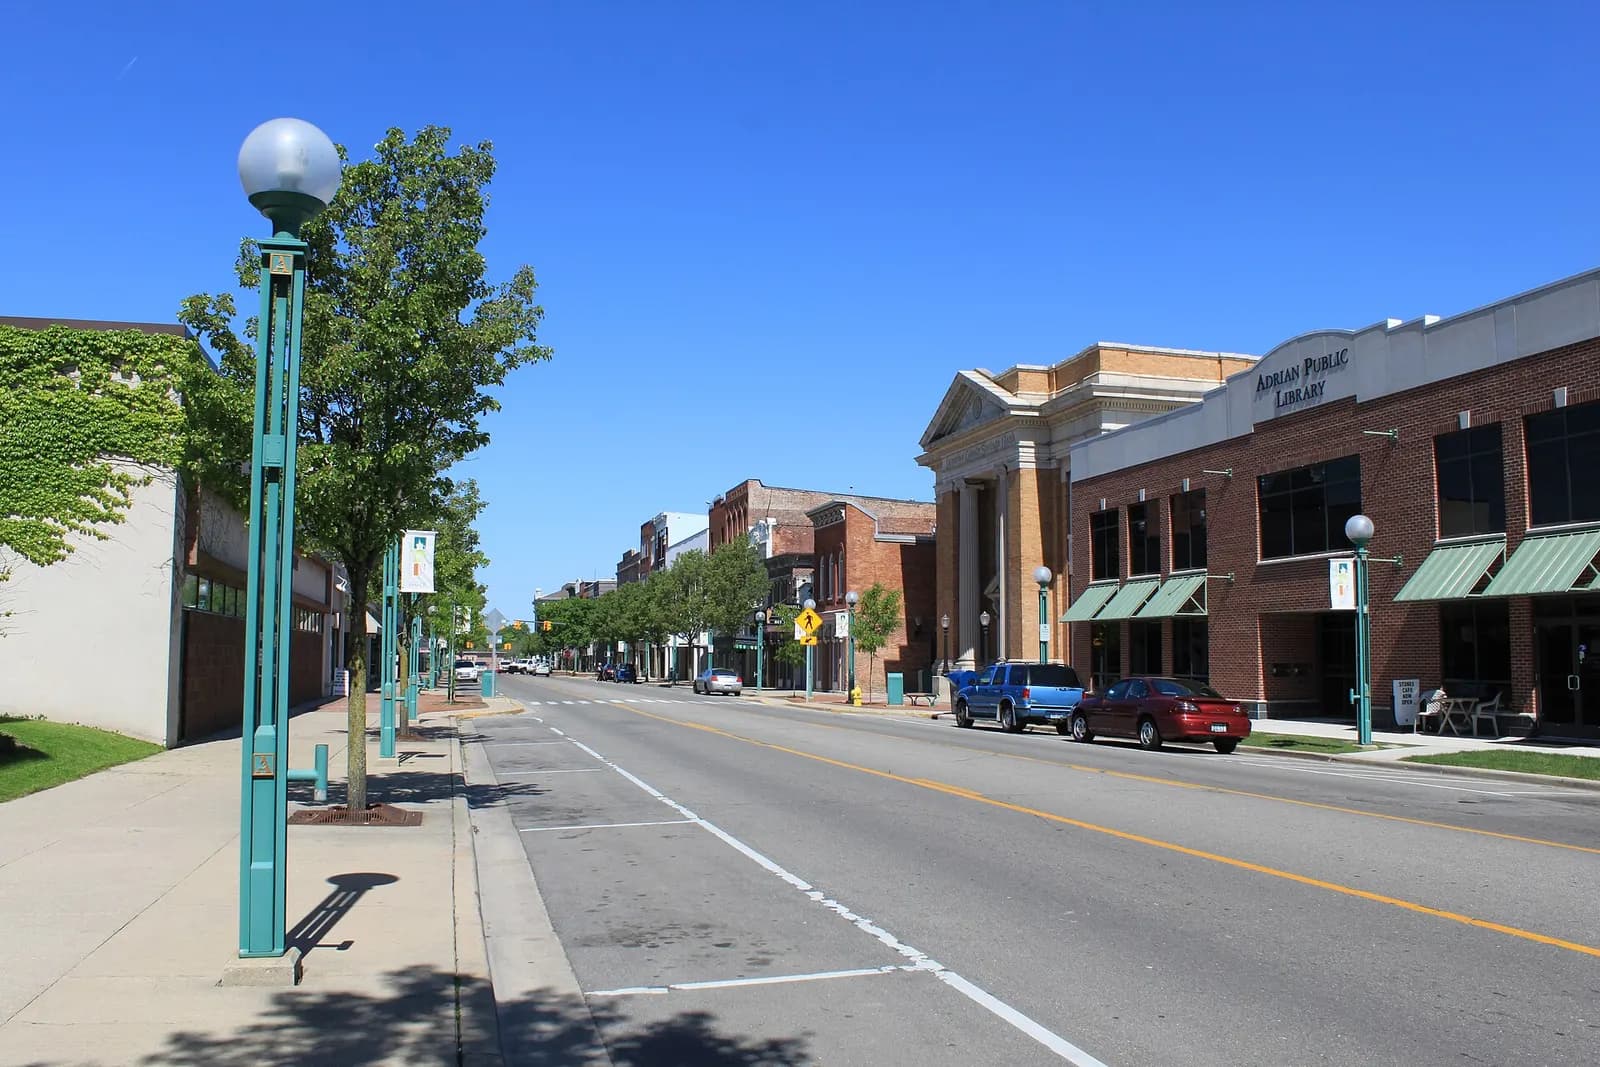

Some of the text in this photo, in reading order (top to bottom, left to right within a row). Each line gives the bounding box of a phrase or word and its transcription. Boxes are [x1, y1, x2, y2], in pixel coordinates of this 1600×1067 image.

[1256, 348, 1349, 392] ADRIAN PUBLIC
[1276, 380, 1326, 408] LIBRARY
